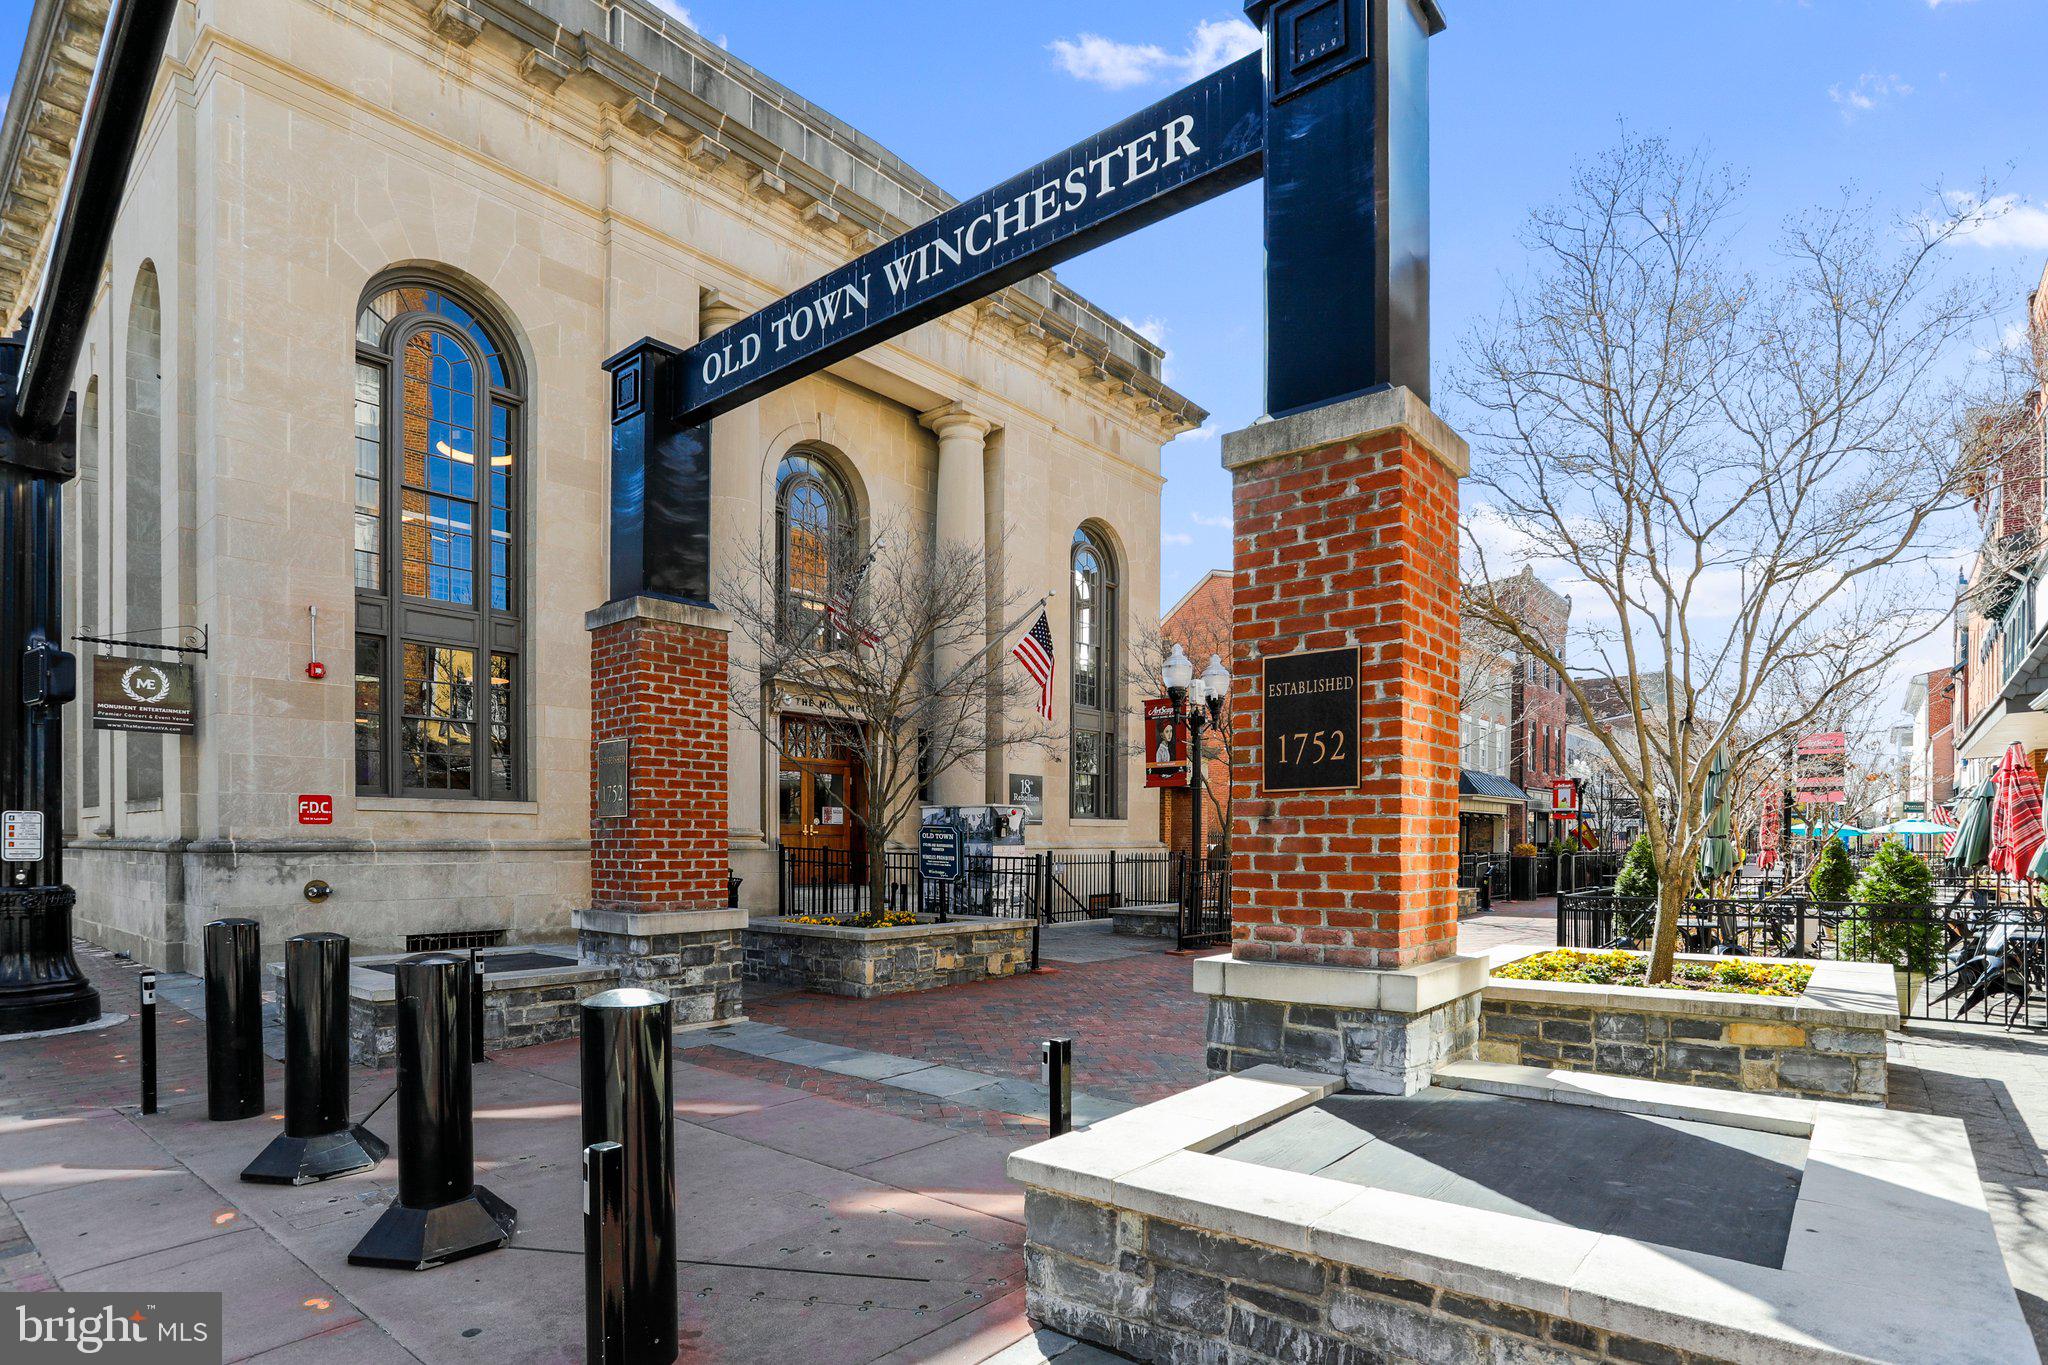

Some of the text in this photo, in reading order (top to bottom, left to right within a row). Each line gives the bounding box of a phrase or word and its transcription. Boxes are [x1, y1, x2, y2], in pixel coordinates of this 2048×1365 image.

[702, 114, 1201, 386] OLD TOWN WINCHESTER
[136, 679, 156, 690] ME
[1269, 676, 1354, 697] ESTABLISHED
[796, 698, 813, 707] THE
[97, 703, 190, 715] MONUMENT ENTERTAINMENT
[1148, 706, 1175, 716] ArtScap
[1278, 730, 1346, 765] 1752
[602, 784, 624, 803] 1752
[1013, 793, 1040, 802] Rebellion
[299, 801, 331, 813] F.D.C.
